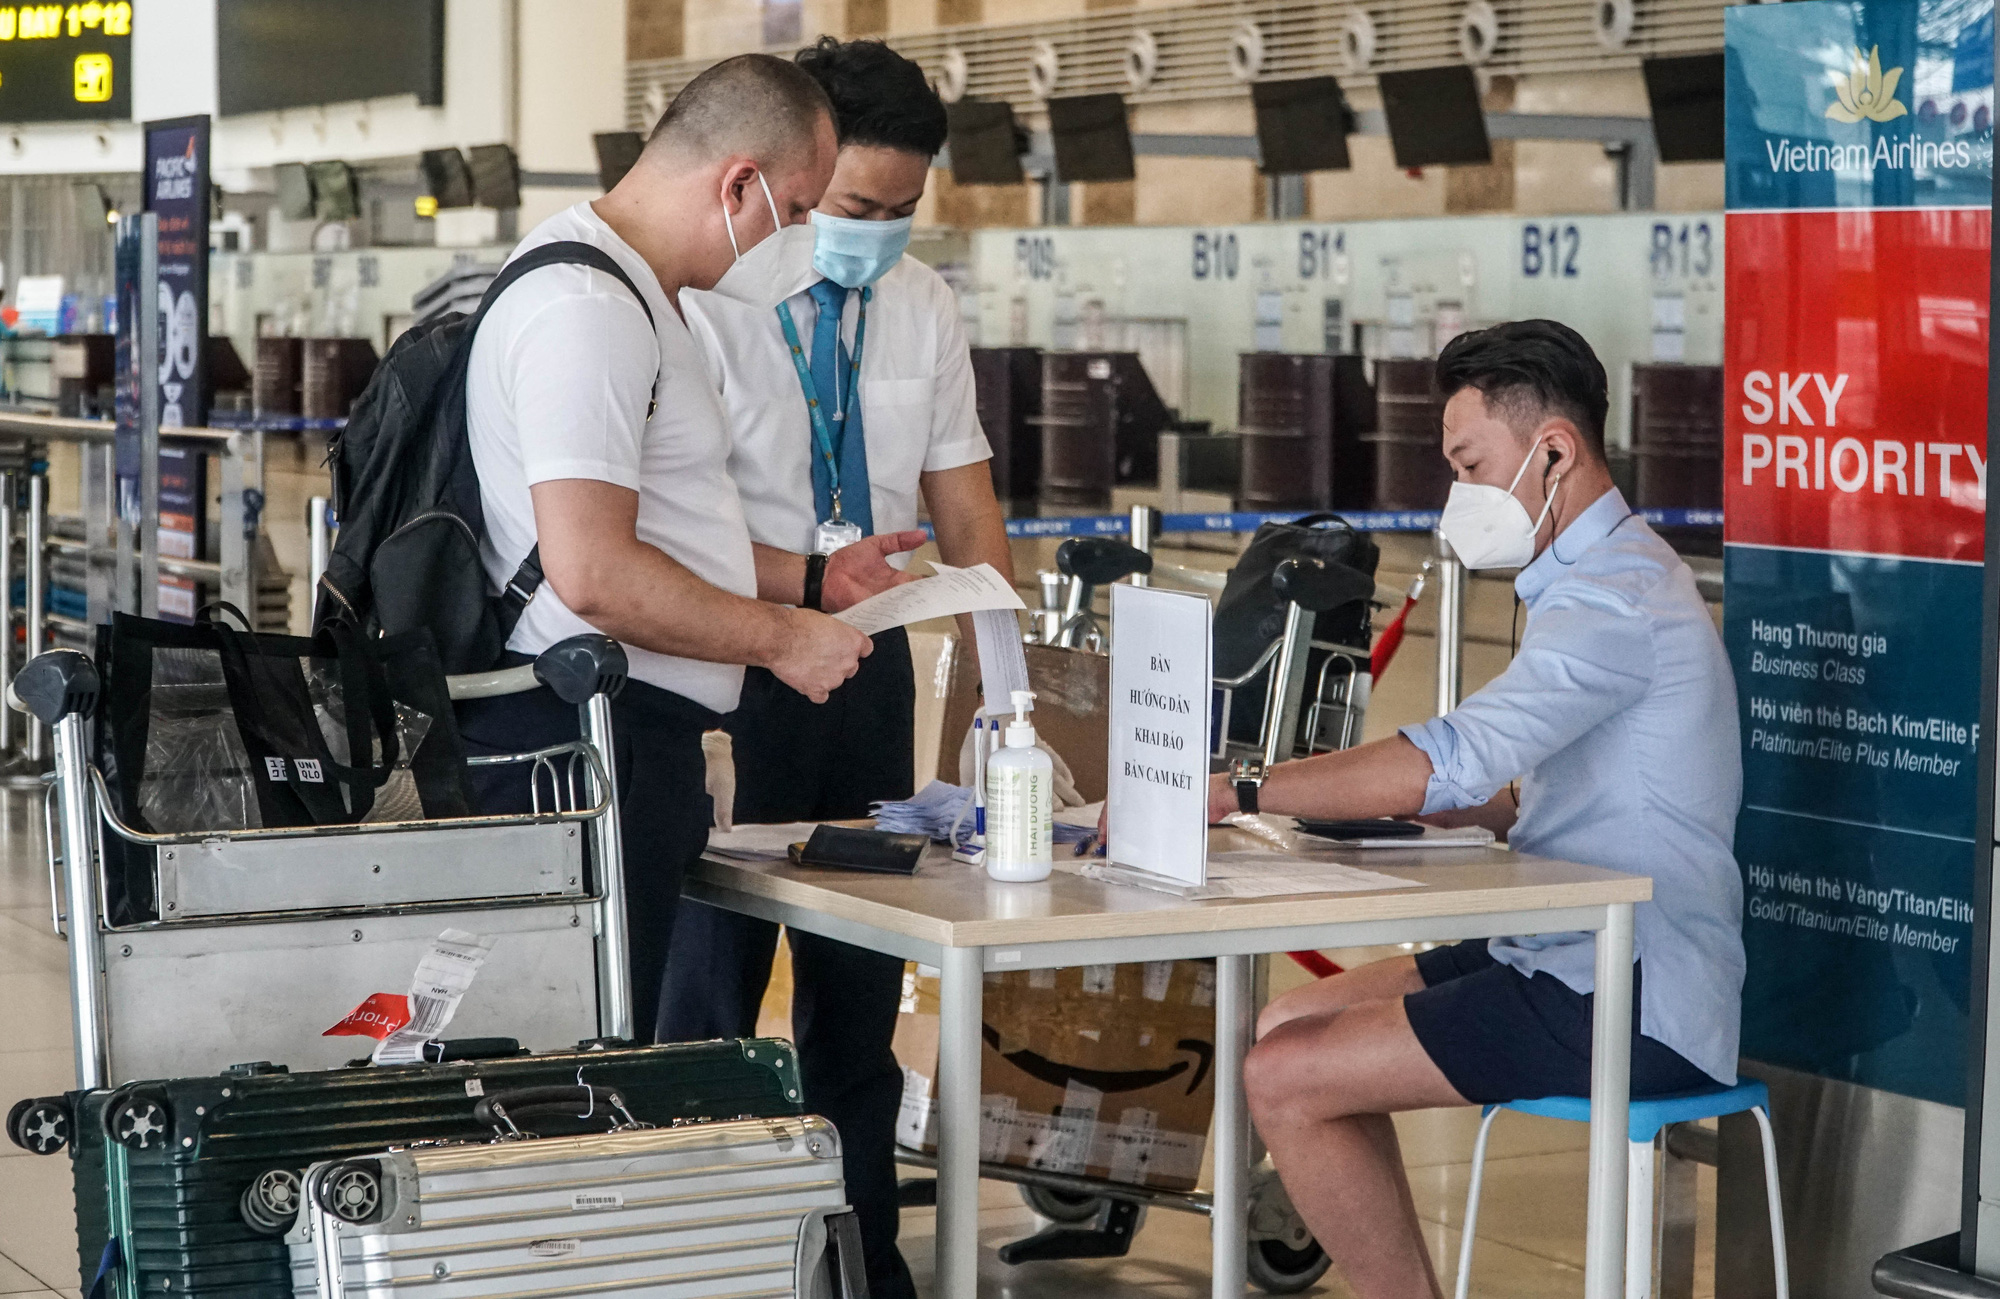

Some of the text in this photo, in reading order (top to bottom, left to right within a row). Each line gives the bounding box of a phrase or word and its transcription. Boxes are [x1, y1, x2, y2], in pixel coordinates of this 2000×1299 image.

[1192, 231, 1240, 280] B10
[1522, 224, 1580, 277] B12
[1742, 370, 1849, 427] SKY
[1742, 433, 1987, 500] PRIORITY
[1751, 619, 1792, 649] Hạng
[1862, 632, 1887, 658] gia
[1751, 651, 1866, 685] Business Class
[1130, 688, 1167, 710] HƯỚNG
[1135, 727, 1184, 751] KHAI BÁO
[1751, 697, 1777, 724] Hội
[1780, 702, 1812, 725] viên
[1846, 708, 1887, 737] Bạch
[1892, 714, 1967, 745] Kim/Elite
[301, 770, 320, 779] QLO
[1750, 729, 1961, 778] Platinum/Elite Plus Member
[1146, 766, 1169, 786] CAM
[1749, 864, 1774, 893] Hội
[1779, 872, 1811, 896] viên
[1749, 896, 1960, 955] Gold/Titanium/Elite Member
